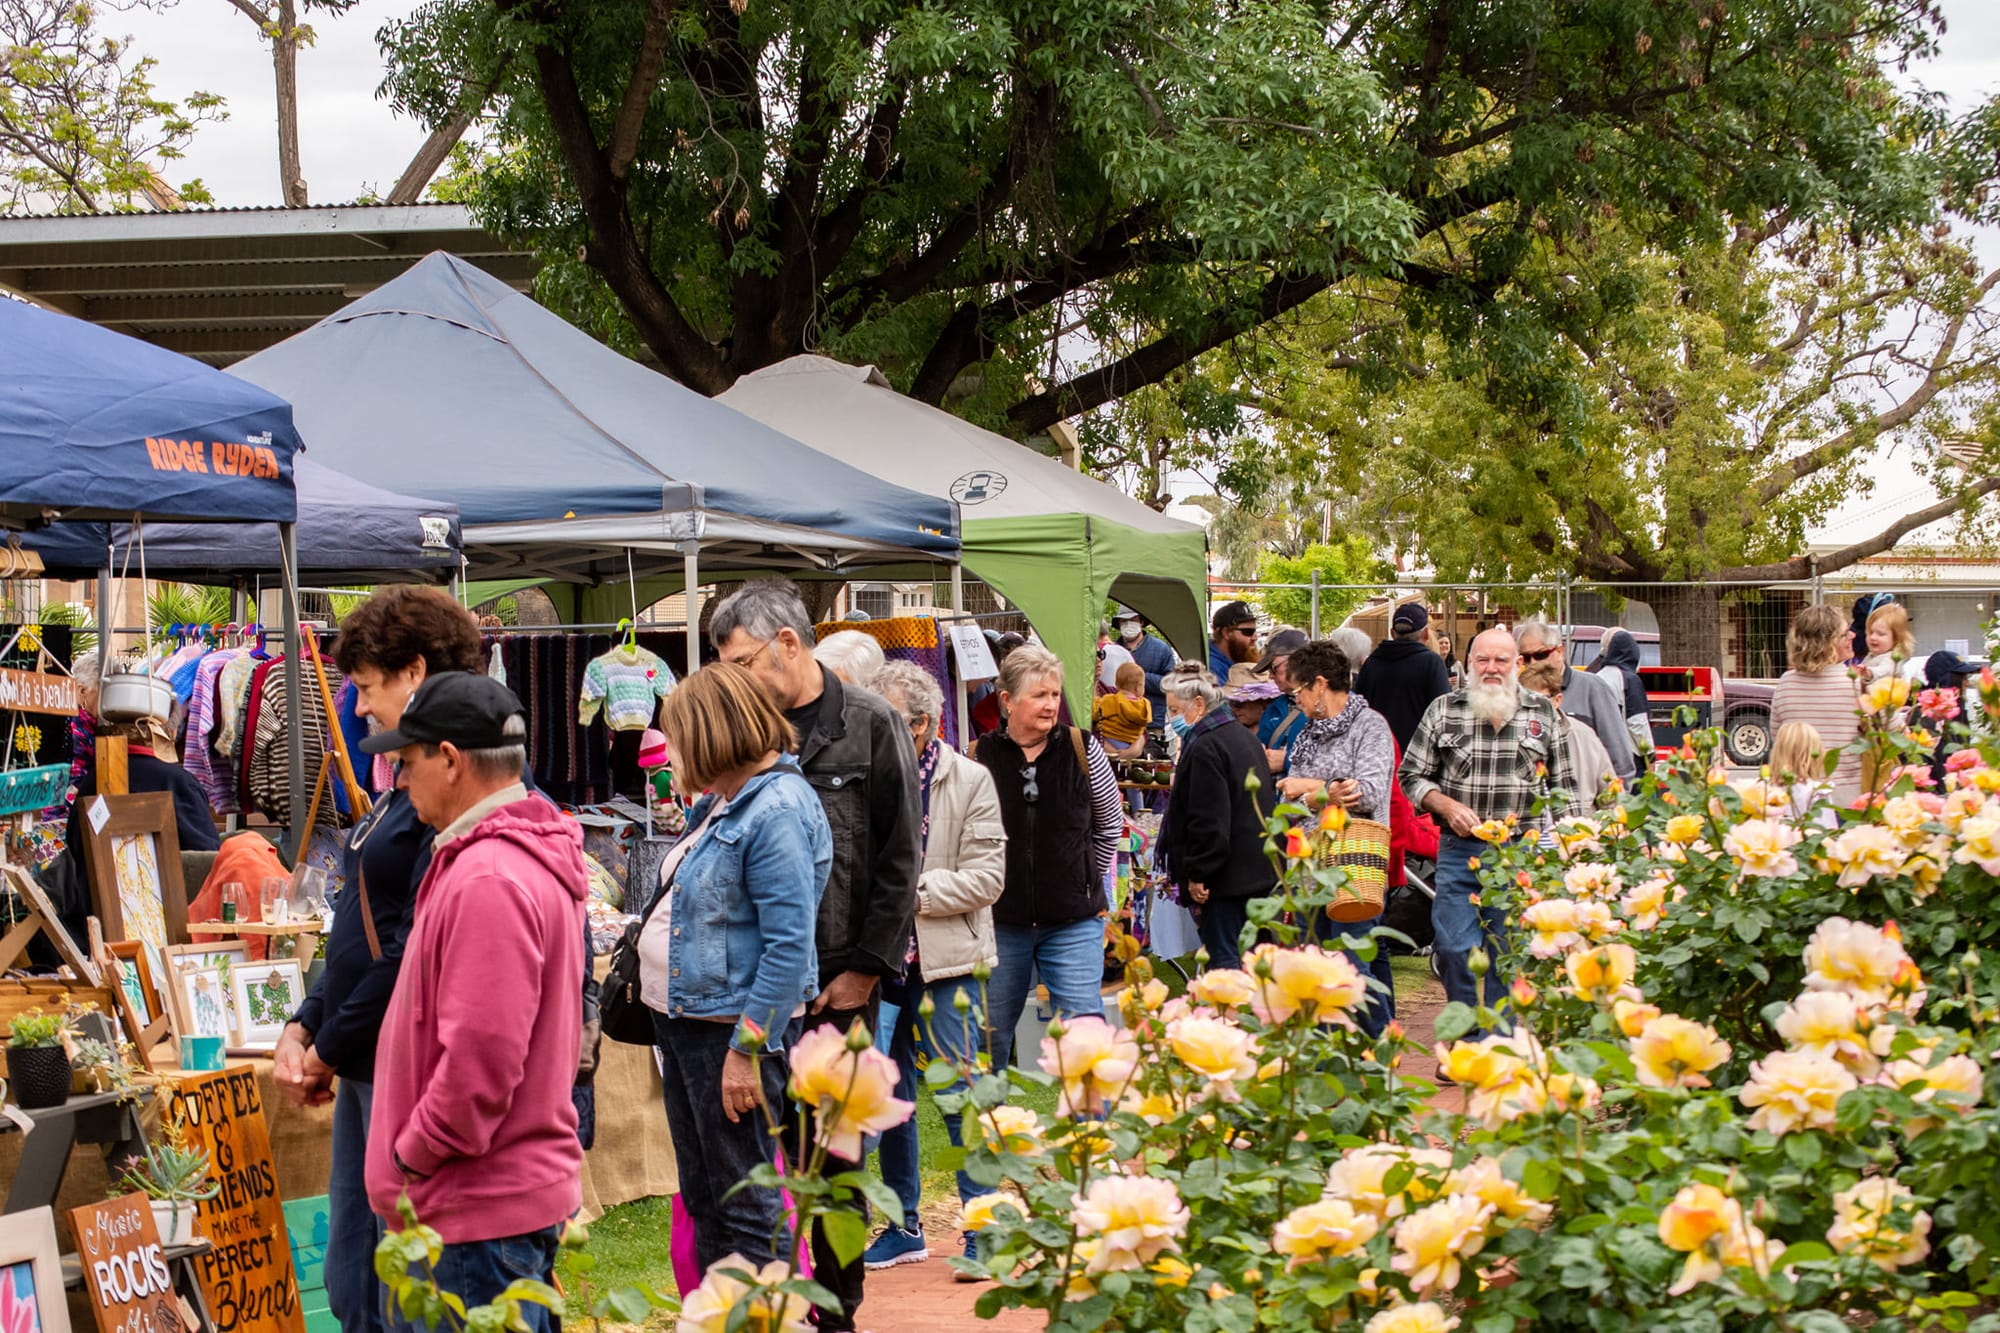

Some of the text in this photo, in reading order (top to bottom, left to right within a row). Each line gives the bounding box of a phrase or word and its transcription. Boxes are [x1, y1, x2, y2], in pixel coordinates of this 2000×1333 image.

[145, 436, 280, 479] RIDGE RYDER
[33, 678, 41, 705] is
[0, 777, 50, 808] elcome
[213, 1117, 233, 1173] &
[86, 1208, 142, 1256] Music
[211, 1210, 261, 1239] MAKE THE
[93, 1243, 171, 1307] ROCKS
[202, 1234, 273, 1283] PERECT
[214, 1260, 295, 1333] Blend
